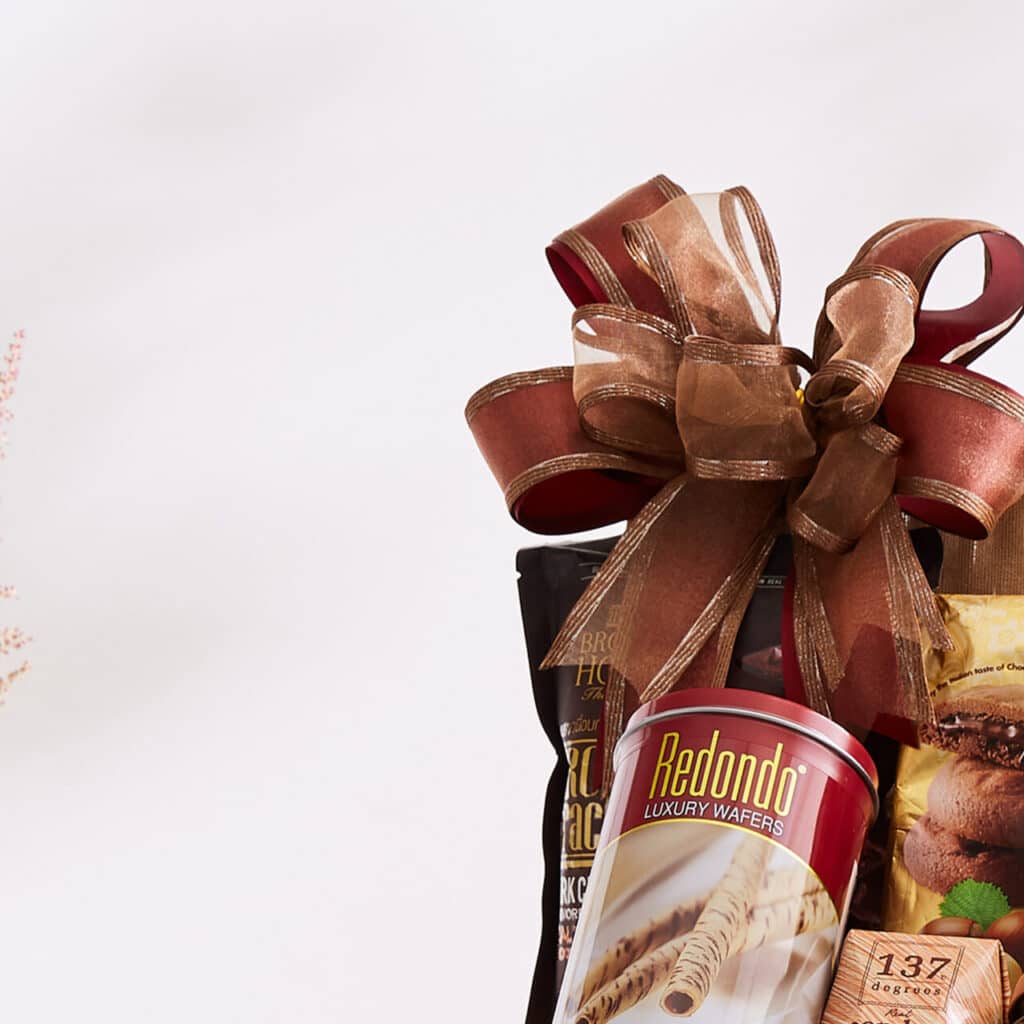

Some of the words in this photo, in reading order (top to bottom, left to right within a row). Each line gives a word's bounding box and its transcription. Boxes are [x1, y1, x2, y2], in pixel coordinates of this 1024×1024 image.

[996, 663, 1005, 671] of
[649, 730, 798, 817] Redondo
[644, 801, 710, 819] LUXURY
[713, 803, 785, 836] WAFERS
[876, 953, 951, 980] 137
[871, 981, 942, 995] degrees
